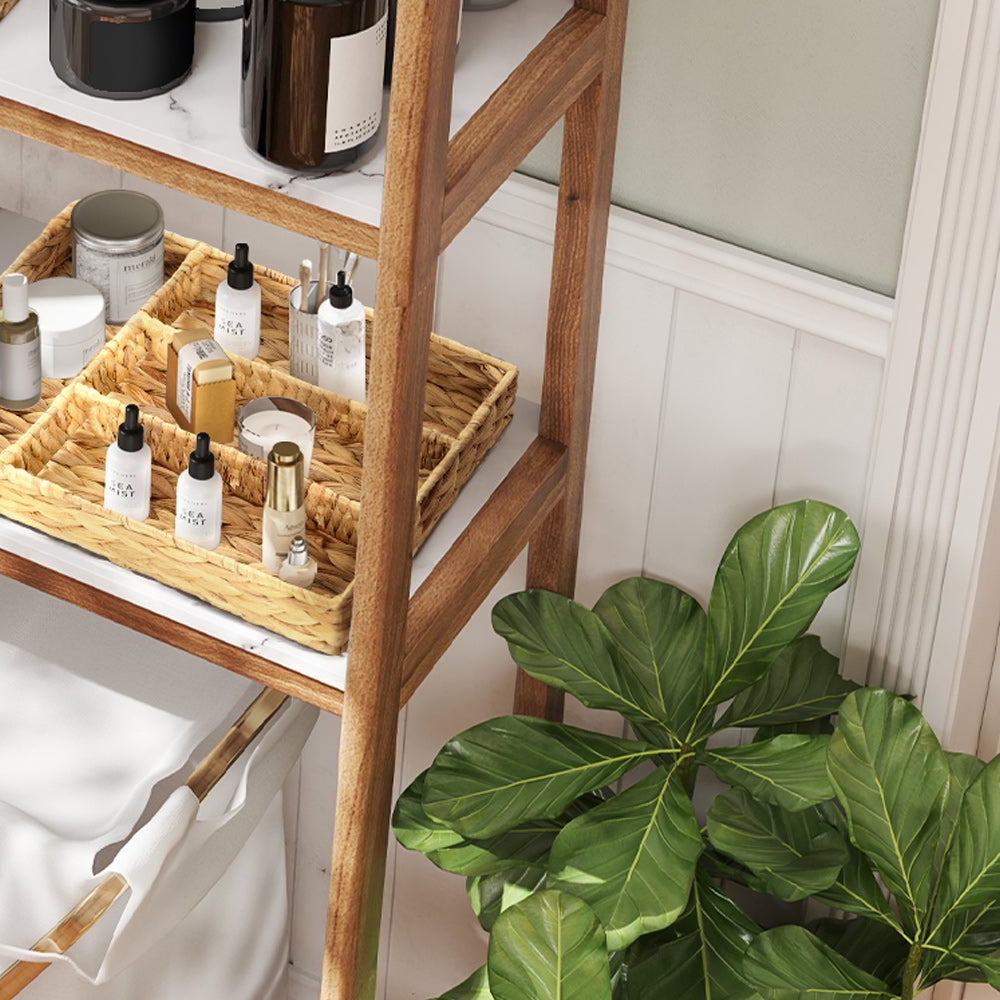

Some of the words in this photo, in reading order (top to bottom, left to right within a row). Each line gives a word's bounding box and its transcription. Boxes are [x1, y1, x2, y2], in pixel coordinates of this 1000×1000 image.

[221, 318, 243, 329] SEA
[218, 323, 246, 336] MIST
[111, 480, 134, 491] SEA
[109, 486, 136, 498] MIST
[182, 508, 205, 519] SEA
[180, 514, 207, 526] MIST
